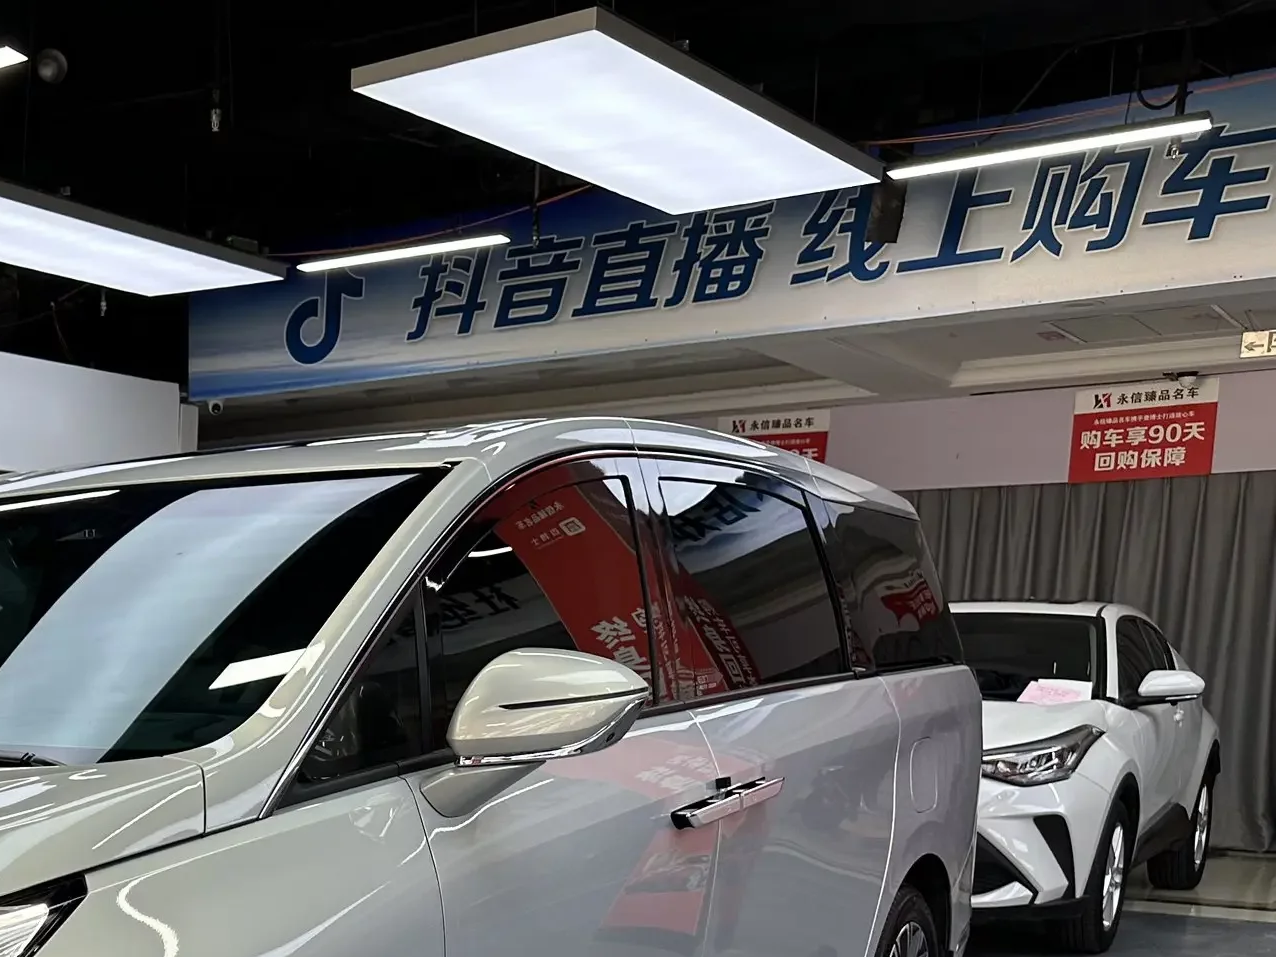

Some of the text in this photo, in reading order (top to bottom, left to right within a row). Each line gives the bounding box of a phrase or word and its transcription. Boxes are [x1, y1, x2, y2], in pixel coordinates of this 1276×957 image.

[405, 122, 1276, 343] 抖音直播 线上购车
[1116, 386, 1200, 406] 永信臻品名车
[1079, 421, 1206, 450] 购车享90天
[1093, 446, 1187, 472] 回购保障
